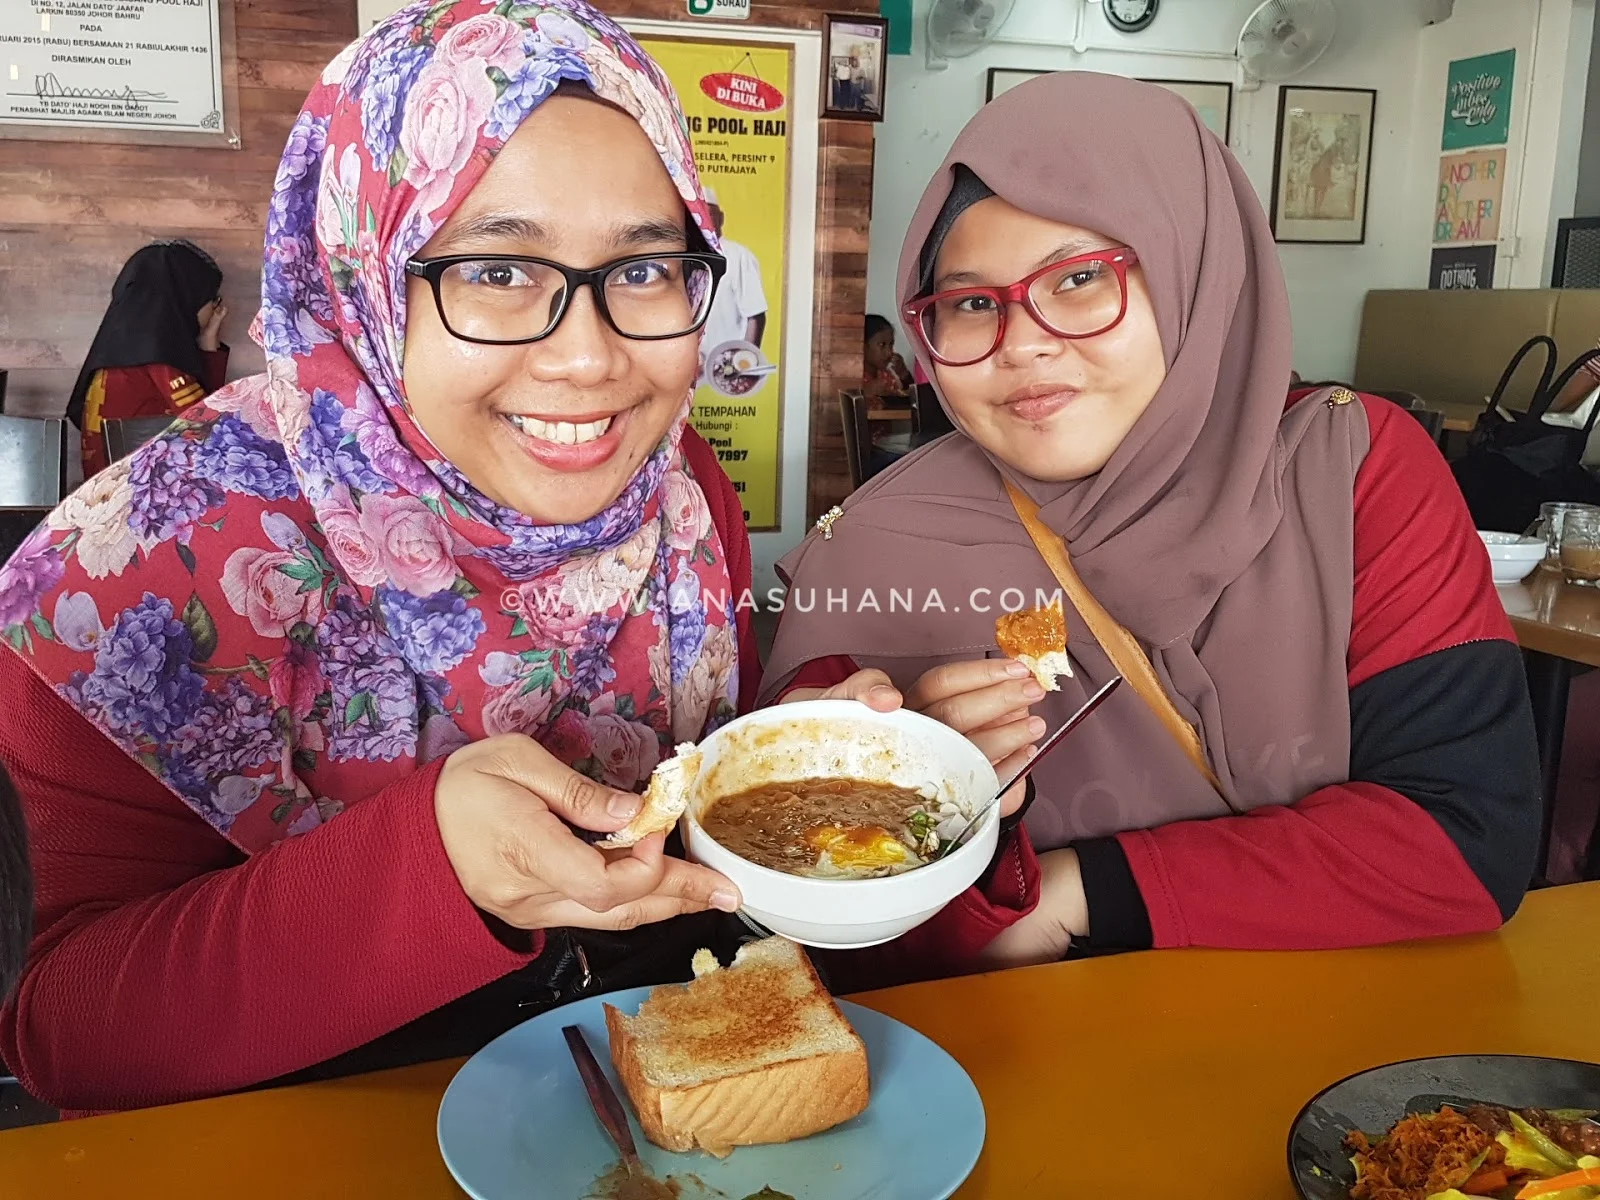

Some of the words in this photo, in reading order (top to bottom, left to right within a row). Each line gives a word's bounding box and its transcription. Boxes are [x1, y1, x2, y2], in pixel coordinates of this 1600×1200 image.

[67, 2, 92, 10] JALAN
[116, 5, 145, 13] JAAFAR
[87, 10, 113, 18] JOHOR
[114, 12, 141, 20] BAHRU
[79, 24, 103, 33] PADA
[73, 39, 123, 49] BERSAMAAN
[125, 41, 134, 49] 21
[136, 42, 189, 53] RABIULAKHIR
[51, 54, 106, 65] DIRASMIKAN
[108, 57, 132, 66] OLEH
[731, 78, 757, 93] KINI
[717, 88, 731, 101] DI
[732, 92, 766, 109] BUKA
[707, 117, 748, 135] POOL
[753, 119, 786, 136] HAJI
[694, 152, 728, 162] SELERA,
[732, 153, 767, 163] PERSINT
[770, 155, 776, 163] 9
[707, 165, 757, 174] PUTRAJAYA
[699, 406, 756, 417] TEMPAHAN
[696, 421, 733, 431] Hubungi
[709, 437, 732, 448] Pool
[717, 450, 748, 461] 7997
